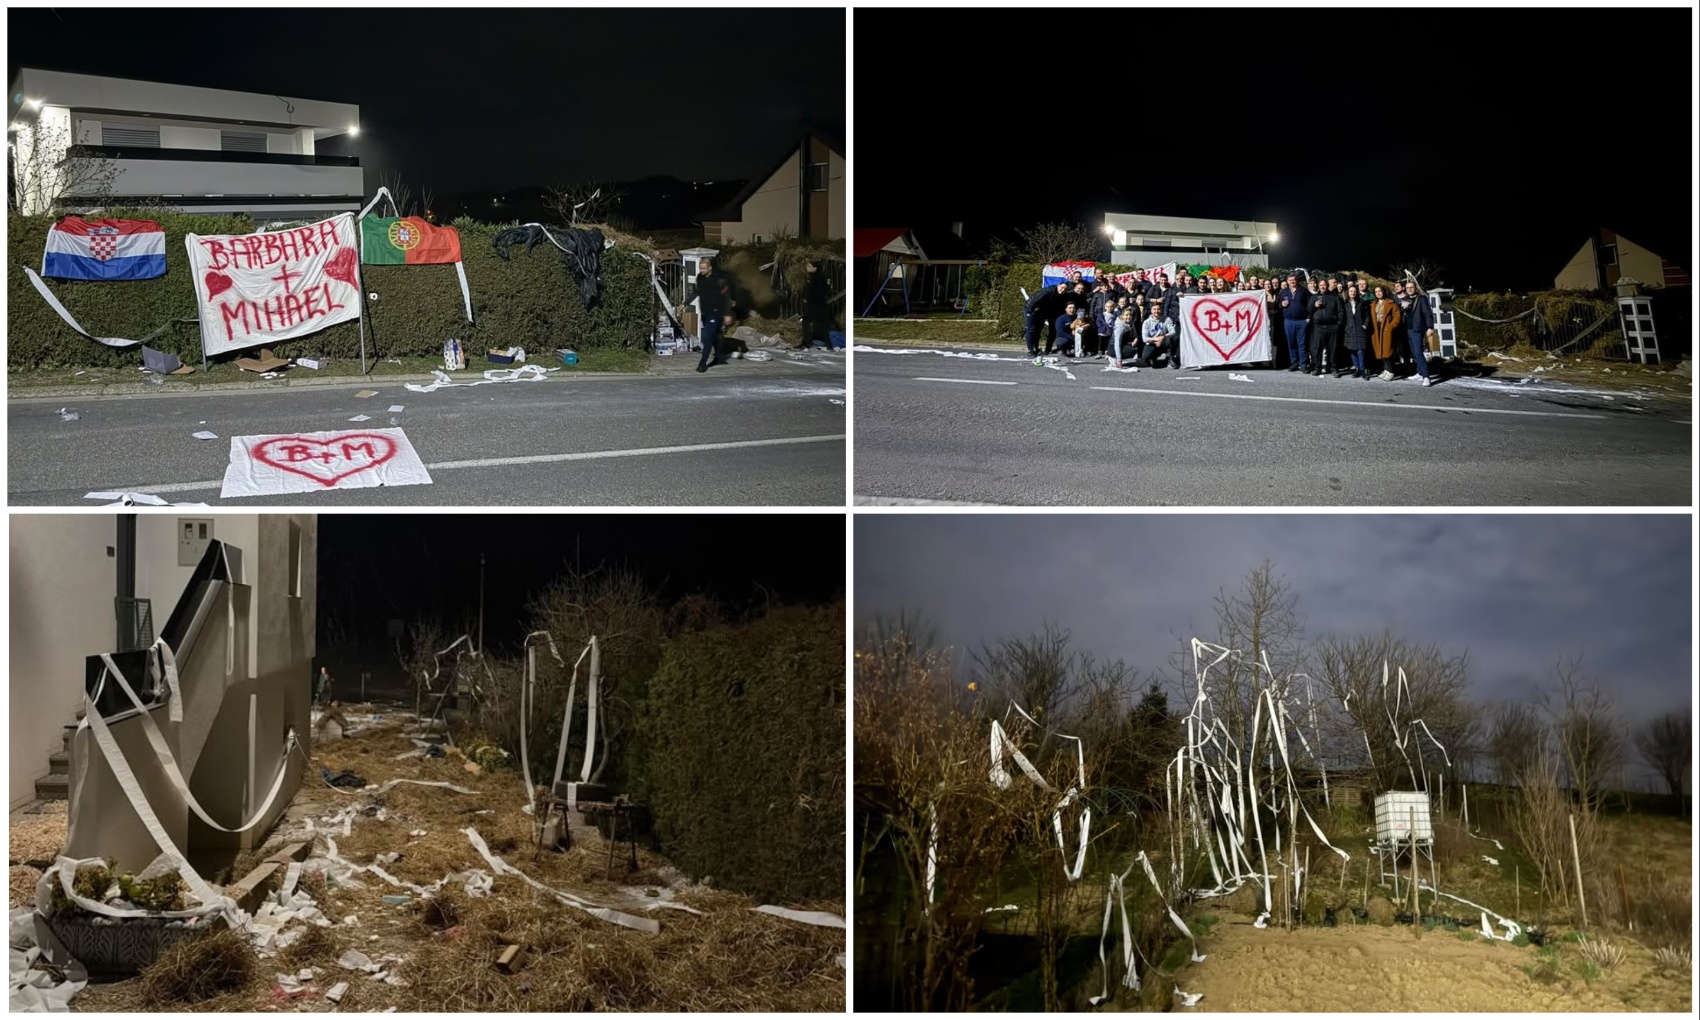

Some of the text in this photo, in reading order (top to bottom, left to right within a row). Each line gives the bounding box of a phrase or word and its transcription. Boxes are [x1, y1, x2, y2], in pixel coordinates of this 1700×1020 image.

[200, 220, 340, 271] BARBARA
[271, 264, 303, 294] +
[220, 282, 345, 341] MIHAEL
[1203, 309, 1252, 336] B+M
[276, 442, 376, 464] B+M
